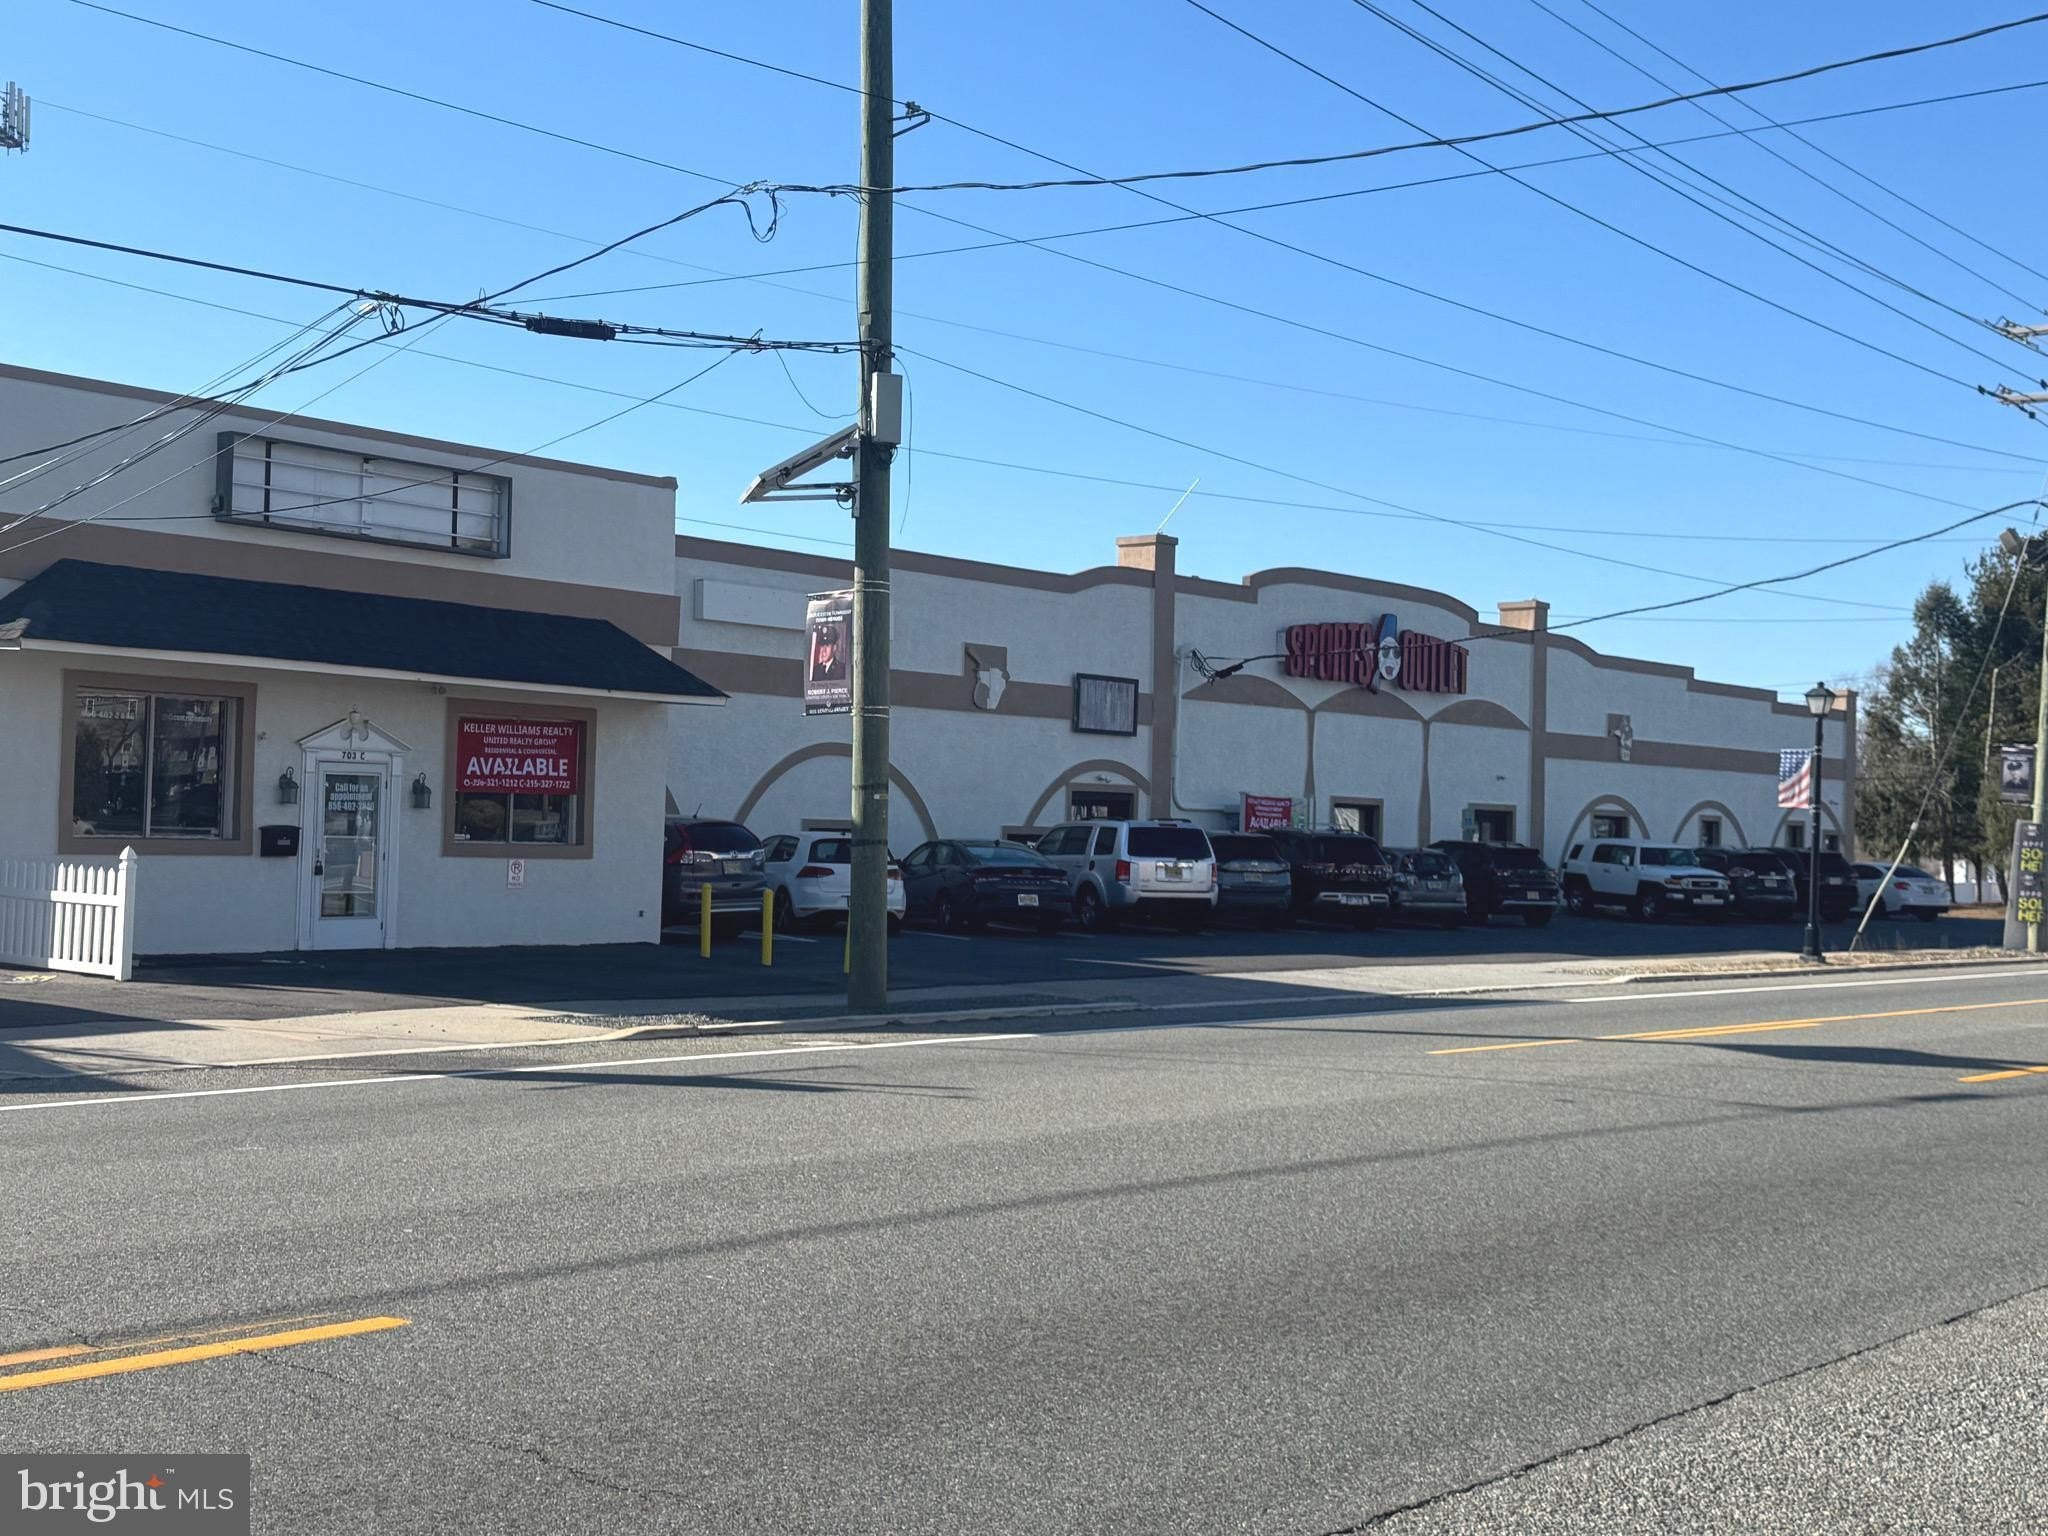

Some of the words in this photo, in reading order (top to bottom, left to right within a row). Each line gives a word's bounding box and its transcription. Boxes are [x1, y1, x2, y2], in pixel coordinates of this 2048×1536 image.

[1285, 622, 1375, 688] SPORTS
[1399, 629, 1470, 695] OUTLET
[463, 722, 496, 734] KELLER
[497, 724, 541, 736] WILLIAMS
[542, 726, 574, 737] REALTY
[483, 736, 508, 744] UNITED
[509, 737, 533, 745] REALTY
[342, 751, 357, 760] 703
[360, 751, 365, 760] C
[466, 756, 569, 777] AVAILABLE
[335, 782, 348, 792] Call
[349, 782, 359, 792] for
[519, 779, 571, 789] C-215-327-1722
[330, 792, 373, 801] appointment
[1249, 816, 1288, 829] AVAILABLE
[2020, 848, 2043, 860] SO
